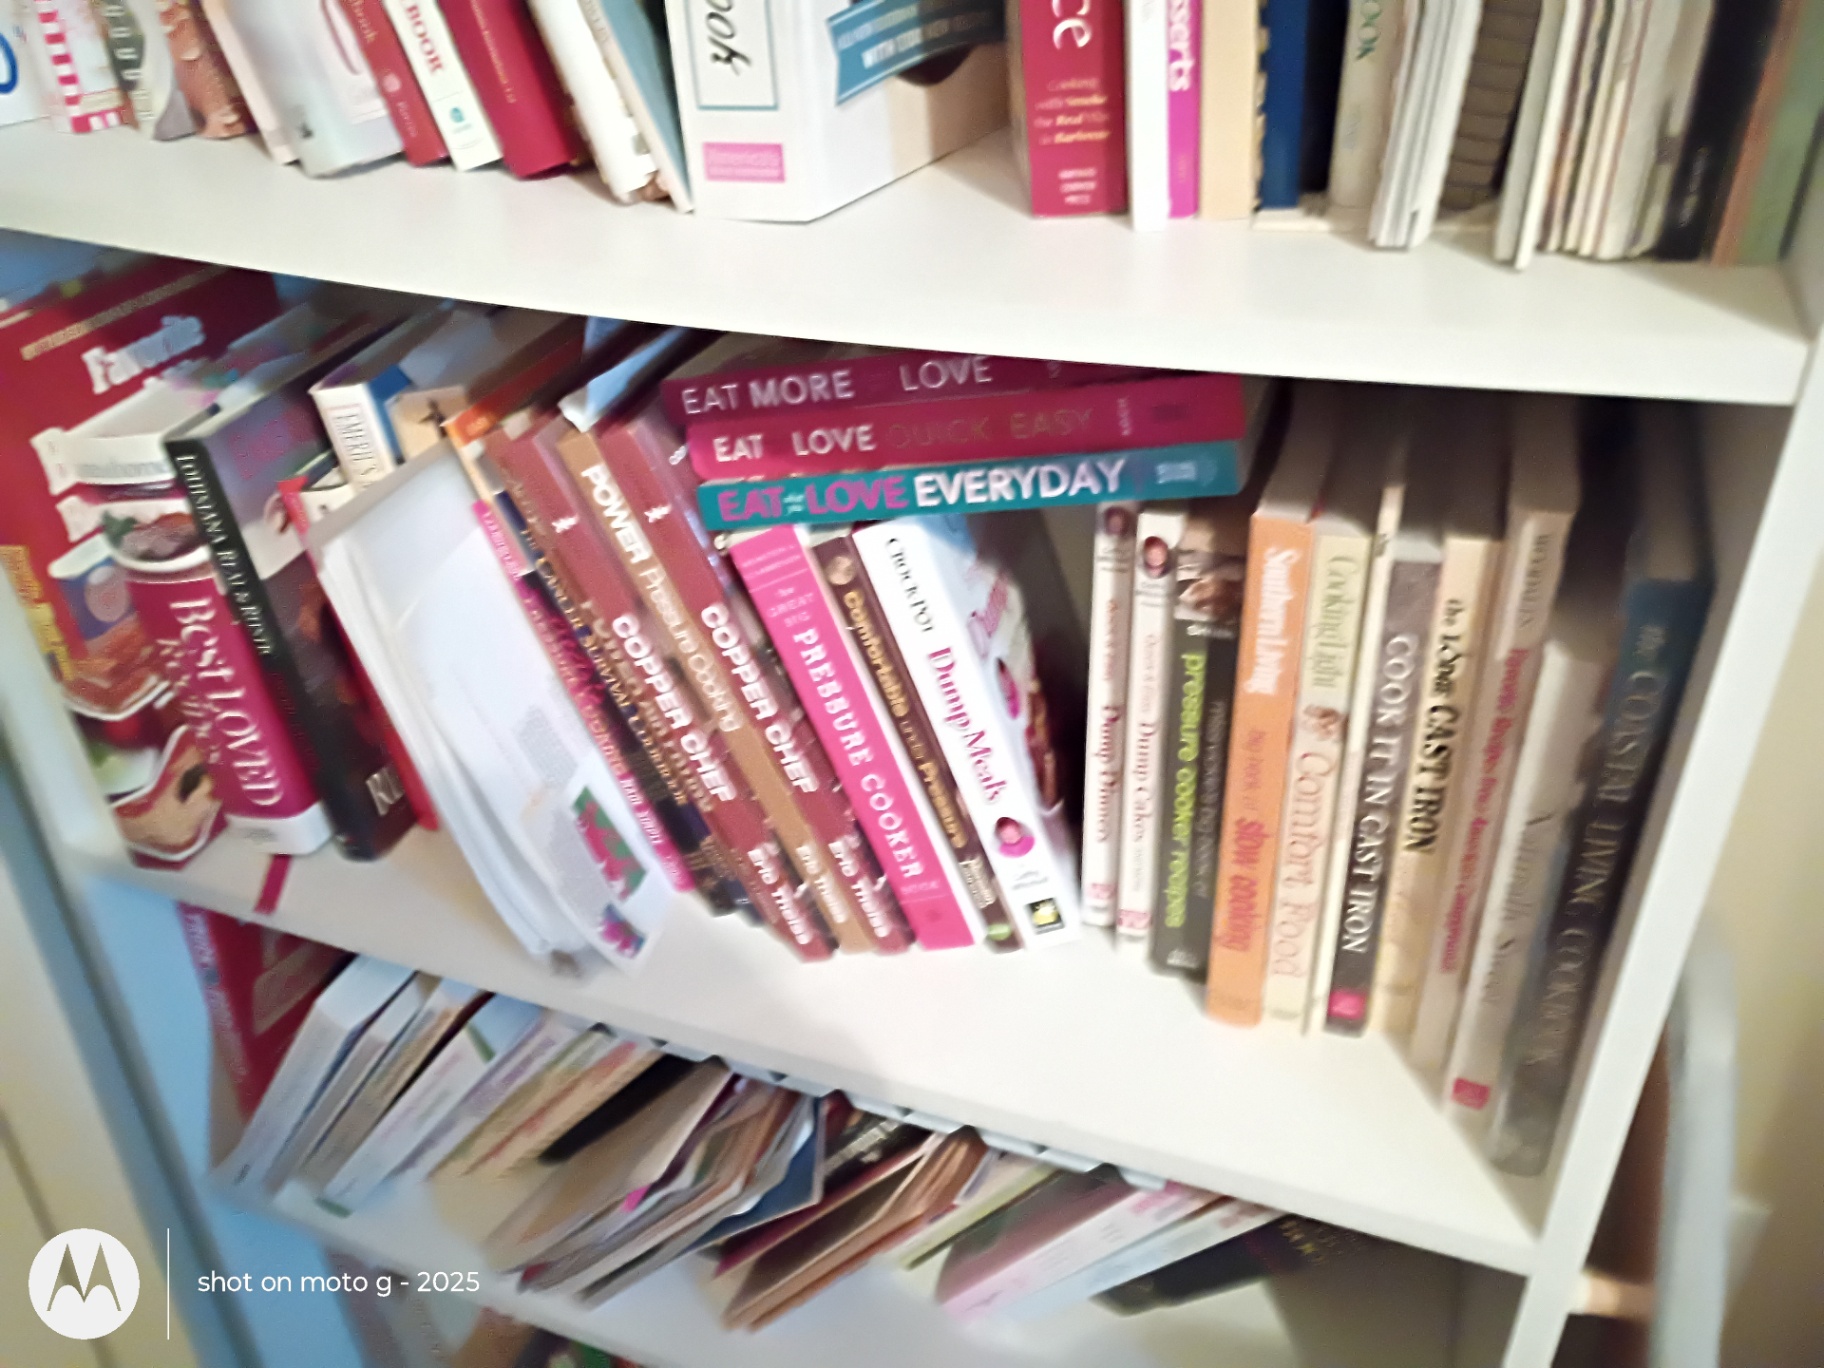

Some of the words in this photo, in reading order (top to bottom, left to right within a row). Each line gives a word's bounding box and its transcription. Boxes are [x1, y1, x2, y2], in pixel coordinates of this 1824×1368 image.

[681, 383, 739, 415] EAT
[749, 370, 855, 408] MORE
[899, 356, 993, 391] LOVE
[712, 434, 763, 463] EAT
[791, 424, 876, 457] LOVE
[717, 486, 785, 522] EAT
[805, 476, 909, 516] LOVE
[913, 458, 1127, 507] EVERYDAY
[580, 462, 652, 565] POWER
[639, 565, 699, 655] Pressure
[611, 612, 695, 730] COPPER
[680, 732, 737, 803] CHEF
[700, 603, 778, 720] COPPER
[765, 724, 820, 793] CHEF
[1178, 654, 1208, 762] pressure
[1375, 633, 1419, 727] COOK
[792, 626, 875, 767] PRESSURE
[860, 773, 924, 878] COOKER
[929, 646, 972, 732] Dump
[963, 728, 1007, 802] Meals
[1132, 722, 1157, 781] Dump
[1369, 734, 1401, 767] IT
[1421, 703, 1461, 781] CAST
[1596, 670, 1668, 803] COASTAL
[1172, 765, 1198, 848] cooker
[1282, 752, 1334, 889] Comfort
[1364, 772, 1396, 806] IN
[1404, 786, 1447, 855] IRON
[1232, 815, 1271, 872] slow
[1353, 813, 1391, 883] CAST
[1164, 850, 1191, 929] recipes
[1213, 873, 1263, 952] cooking
[1340, 887, 1378, 954] IRON
[1271, 898, 1321, 979] Food
